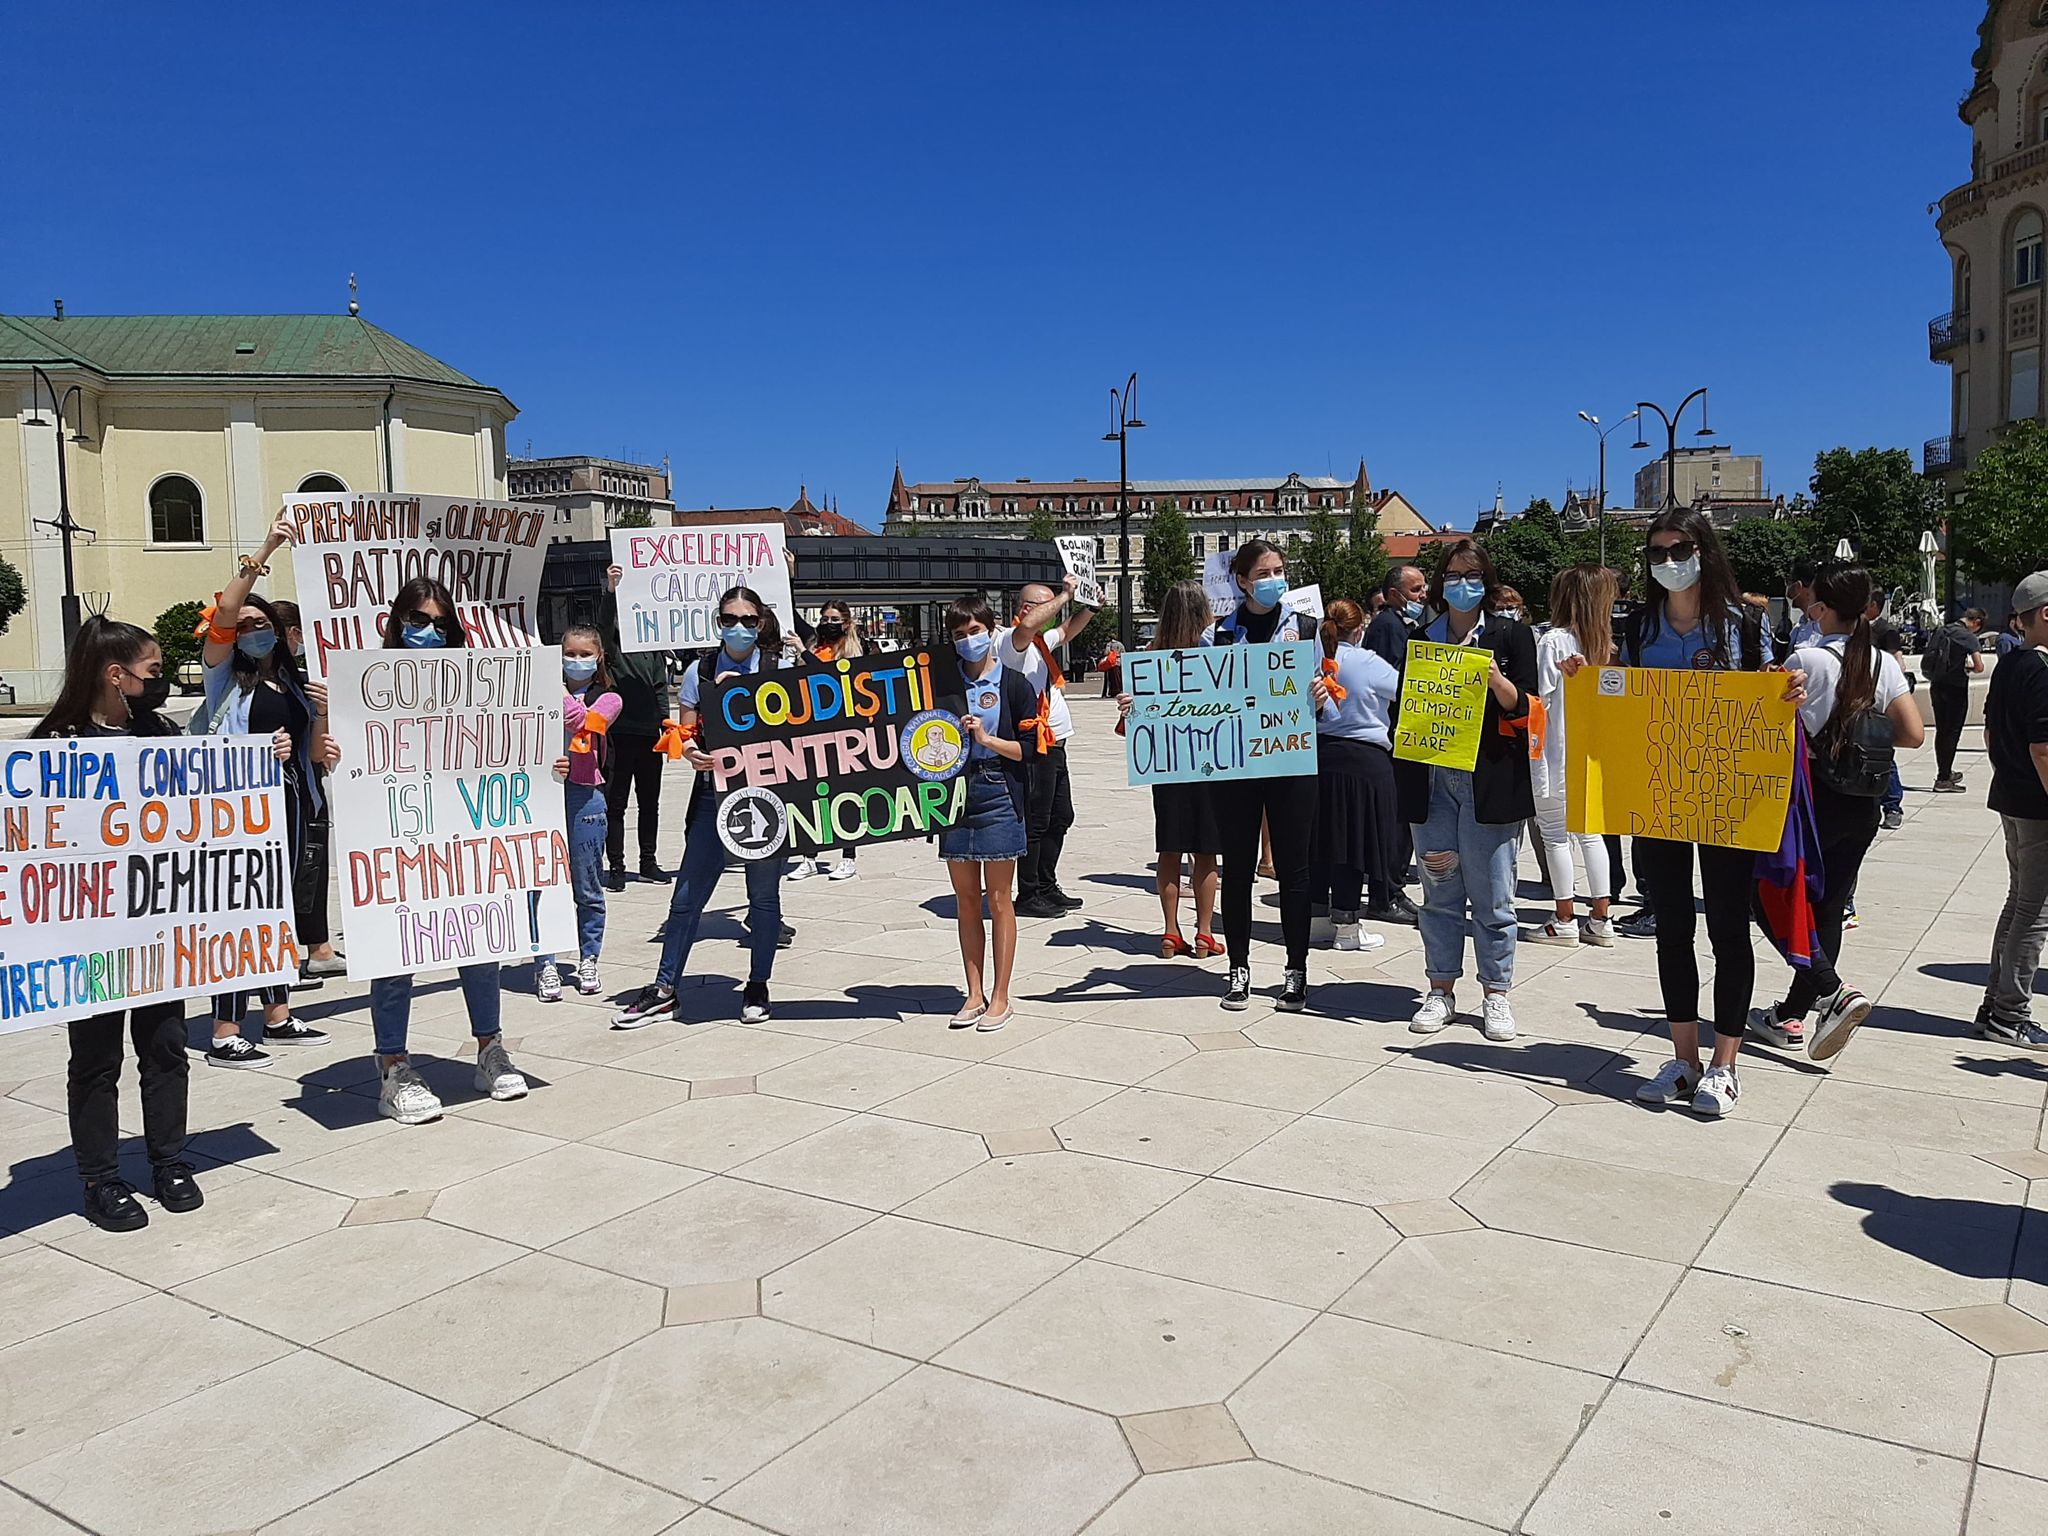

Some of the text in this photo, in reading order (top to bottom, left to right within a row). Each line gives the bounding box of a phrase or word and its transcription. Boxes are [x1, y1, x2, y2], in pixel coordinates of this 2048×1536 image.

[632, 603, 660, 642] ÎN
[1268, 650, 1296, 671] DE
[1440, 667, 1482, 685] DE LA
[1269, 676, 1297, 696] LA
[1407, 679, 1462, 698] TERASE
[1630, 670, 1724, 699] UNITATE
[1161, 695, 1241, 717] terase
[1260, 712, 1283, 729] DIN
[710, 724, 899, 792] PENTRU
[1249, 732, 1312, 757] ZIARE
[1646, 744, 1743, 774] ONOARE
[0, 741, 121, 800] CHIPA
[1648, 766, 1787, 799] AUTORITATE
[457, 772, 532, 829] VOR
[1653, 788, 1750, 821] RESPECT
[100, 794, 271, 846] GOJDU
[349, 830, 571, 907] DEMNITATEA
[20, 861, 117, 924] OPUNE
